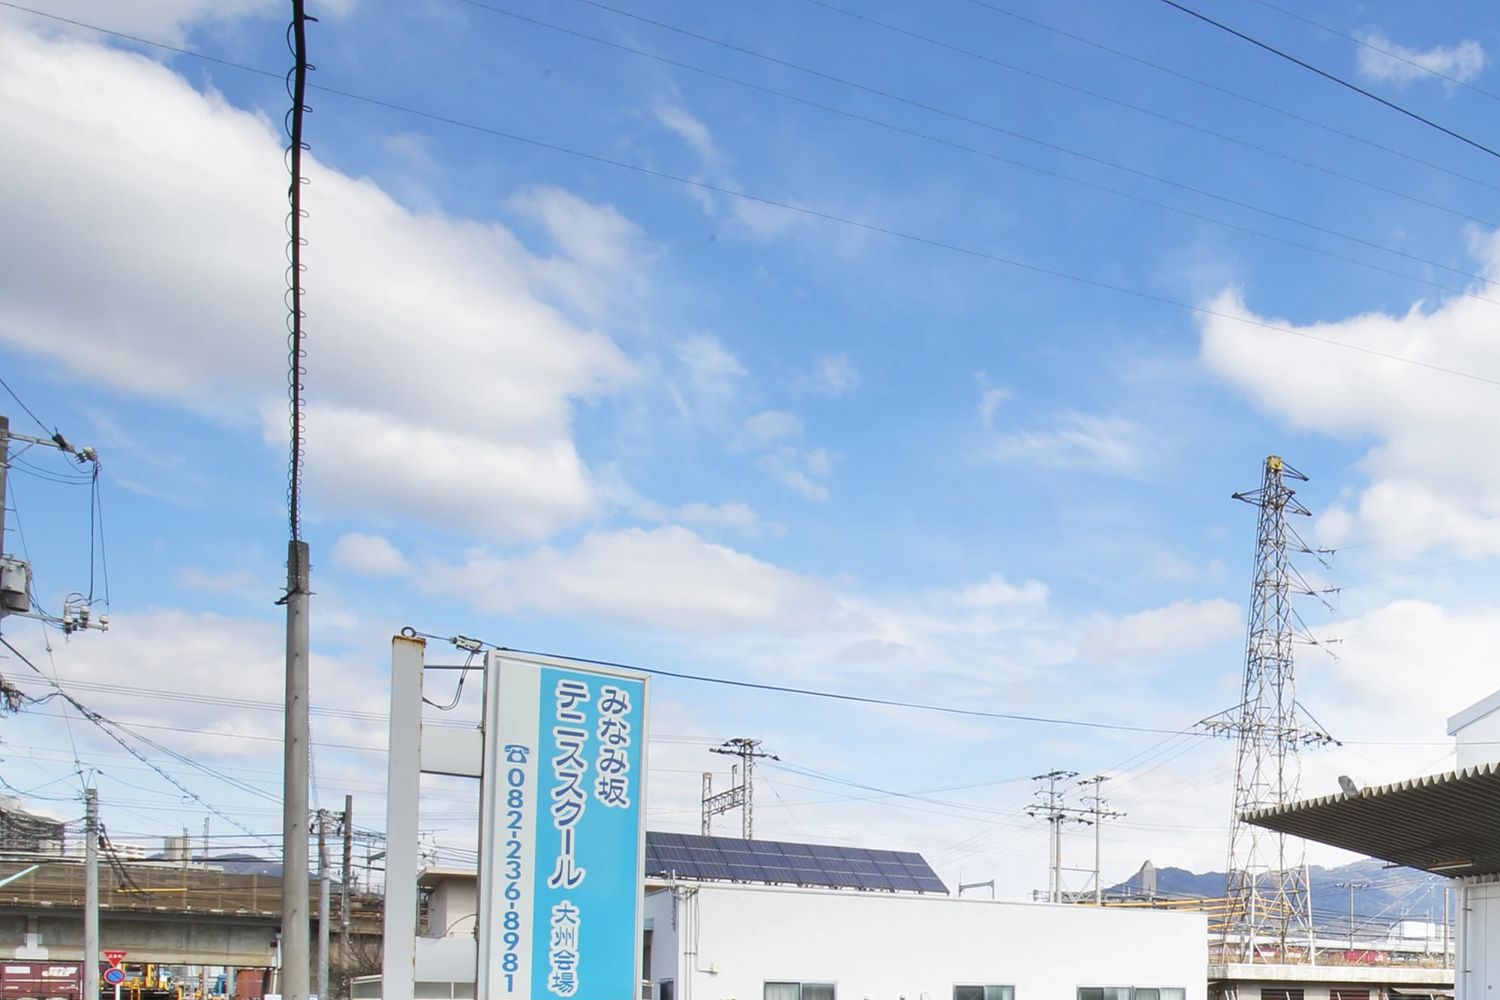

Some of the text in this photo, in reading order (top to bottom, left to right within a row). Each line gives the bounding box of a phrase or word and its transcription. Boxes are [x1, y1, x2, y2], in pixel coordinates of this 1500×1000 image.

[551, 682, 587, 993] テニススクール 大州会場
[598, 688, 629, 805] みなみ坂
[502, 768, 526, 993] 082-236-8981
